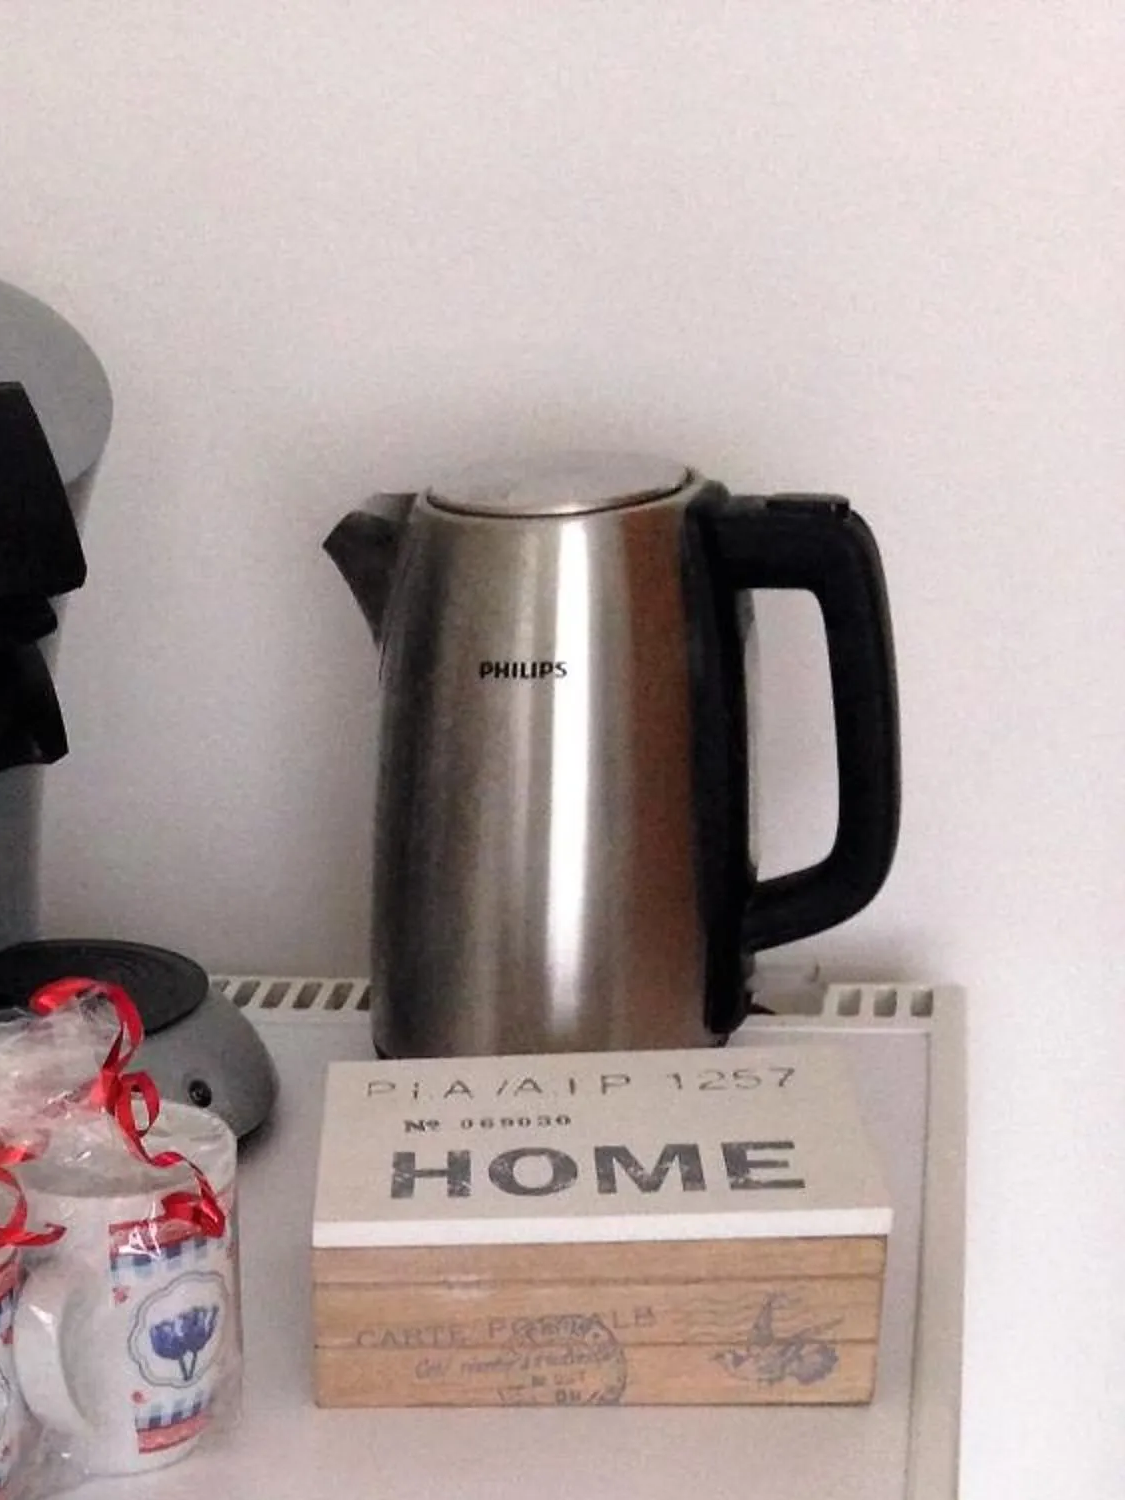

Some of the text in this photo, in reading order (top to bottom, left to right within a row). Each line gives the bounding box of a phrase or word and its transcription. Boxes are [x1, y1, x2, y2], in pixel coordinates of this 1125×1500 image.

[478, 661, 568, 679] PHILIPS
[667, 1067, 796, 1092] 1257
[390, 1140, 807, 1199] HOME
